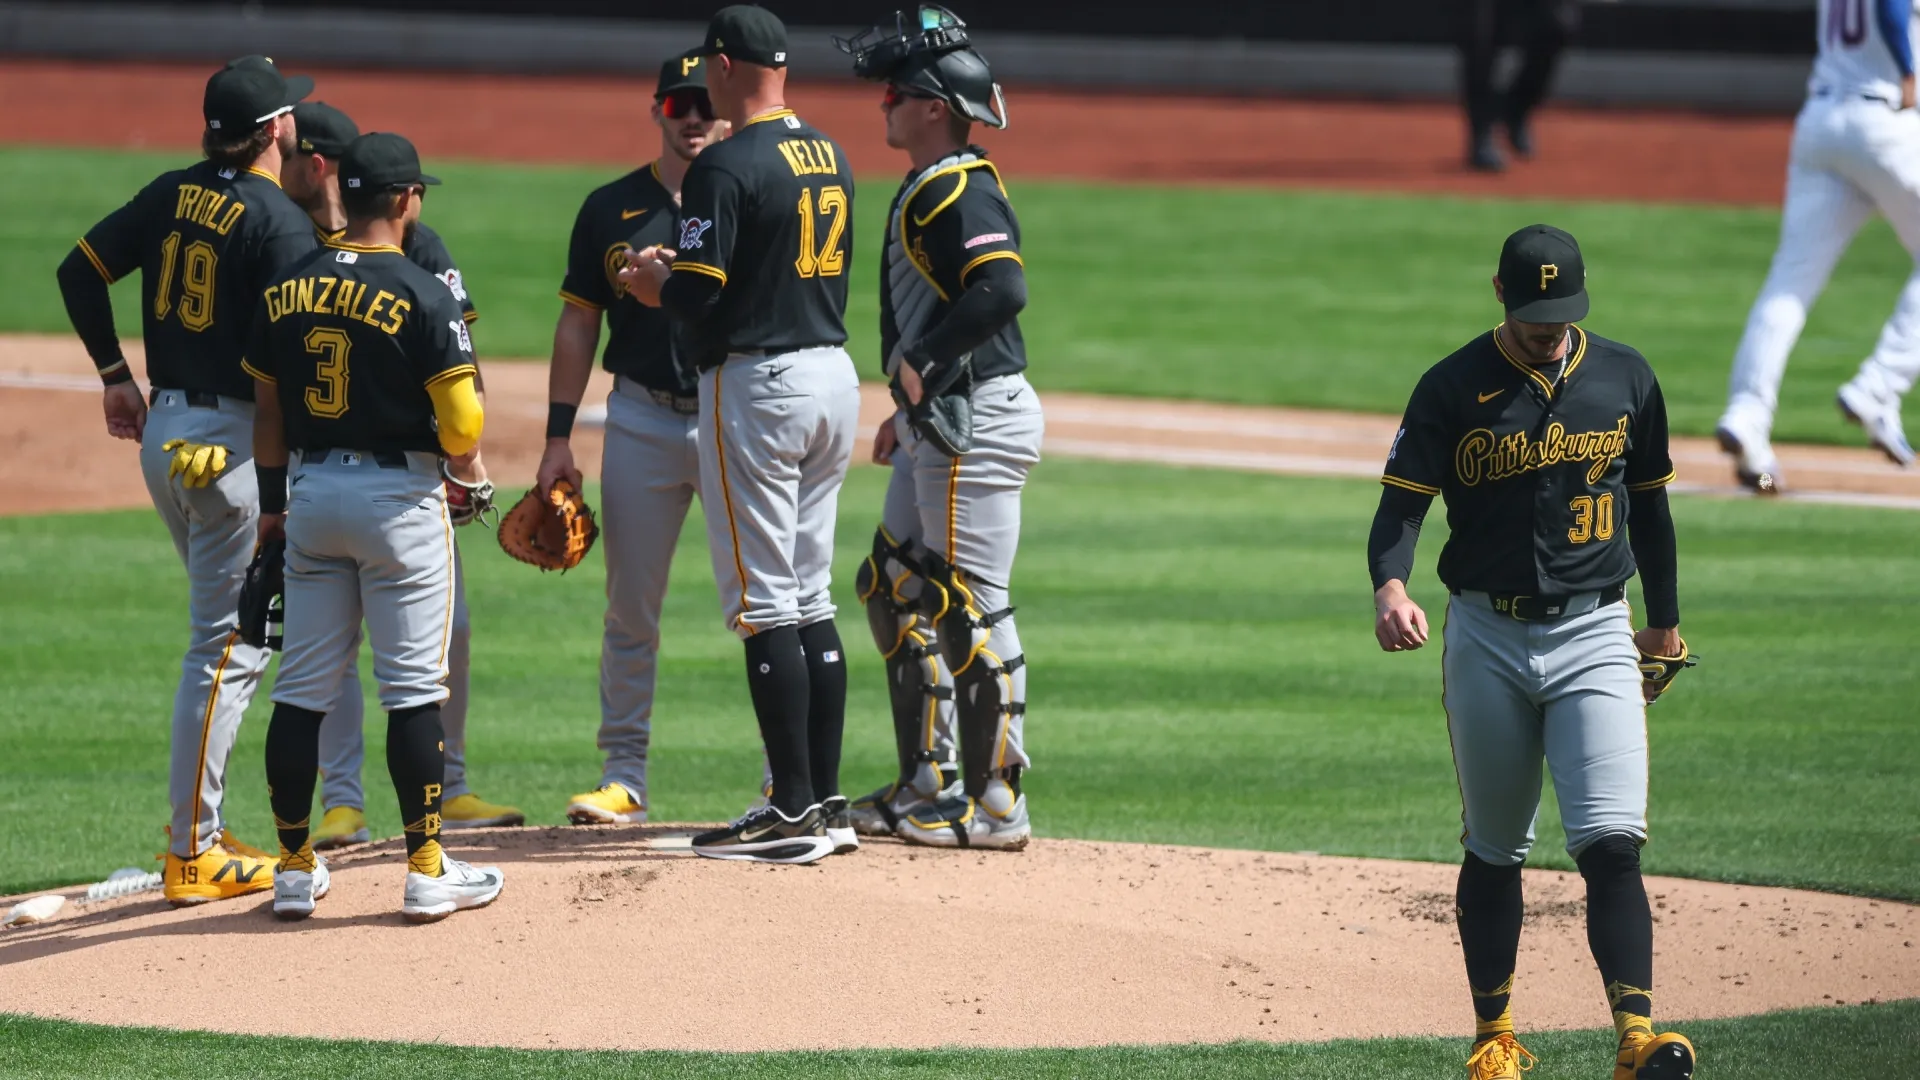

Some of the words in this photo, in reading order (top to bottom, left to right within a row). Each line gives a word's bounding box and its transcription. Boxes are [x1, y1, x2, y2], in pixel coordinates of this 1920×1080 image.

[777, 140, 838, 177] KELLY
[175, 184, 245, 236] TRIOLO
[795, 185, 848, 278] 12
[154, 230, 218, 332] 19
[1540, 263, 1558, 290] P
[264, 276, 411, 335] GONZALES
[304, 326, 353, 419] 3
[1456, 414, 1628, 486] Pittsburgh
[1567, 492, 1615, 544] 30
[1495, 598, 1508, 612] 30
[423, 783, 442, 806] P
[180, 865, 199, 885] 19
